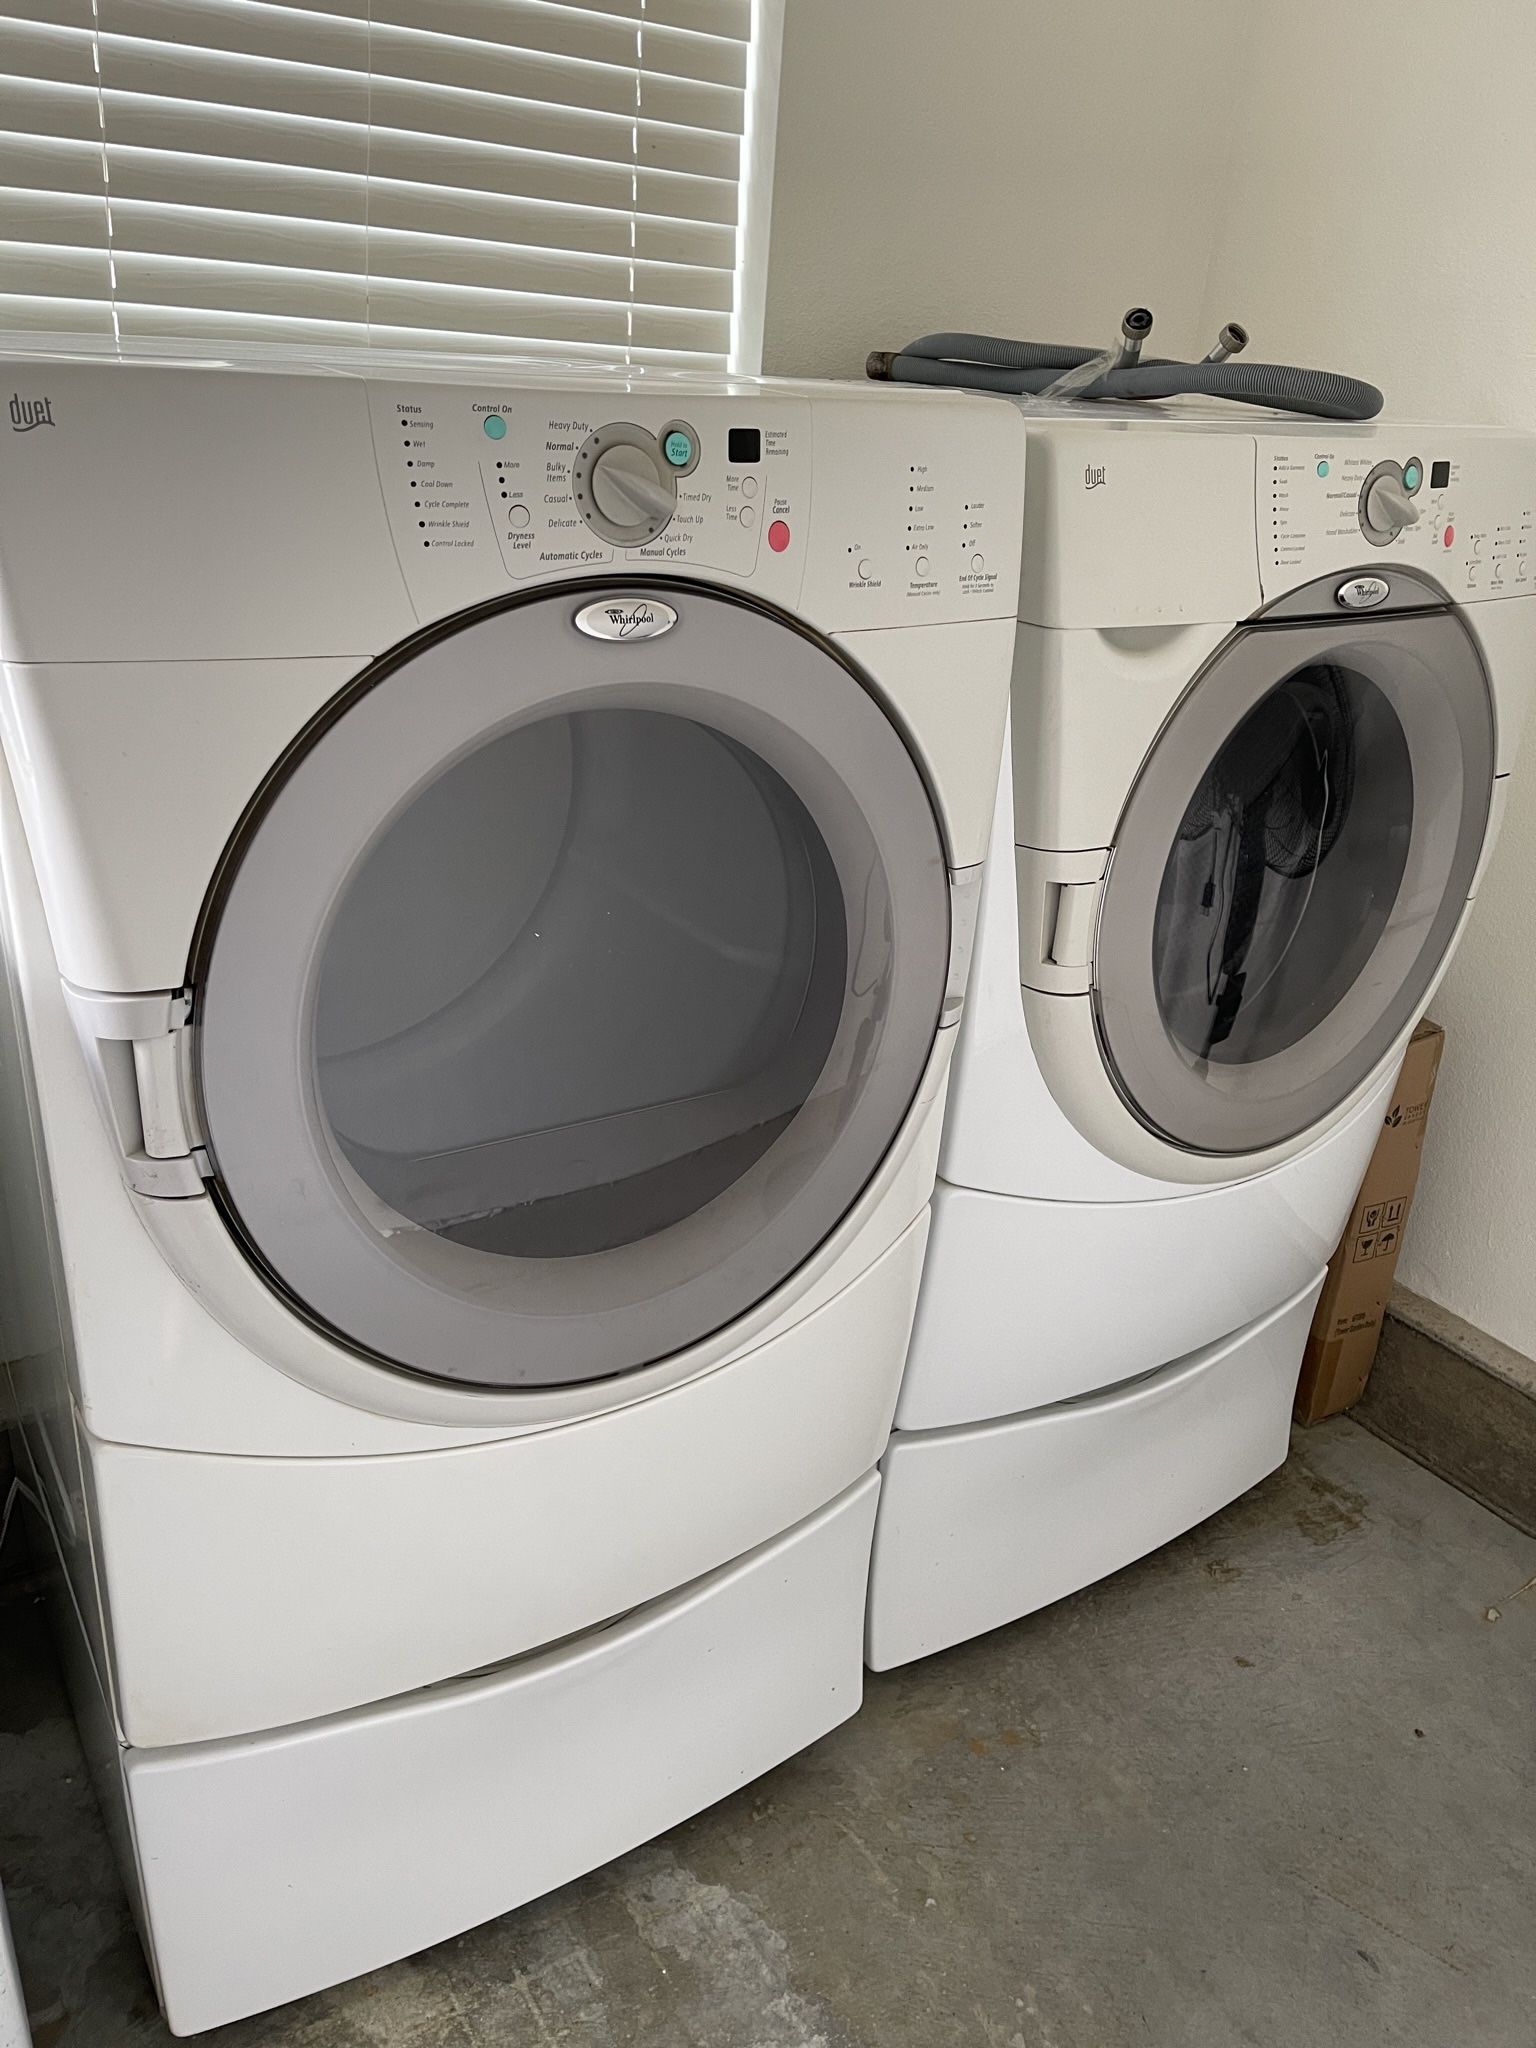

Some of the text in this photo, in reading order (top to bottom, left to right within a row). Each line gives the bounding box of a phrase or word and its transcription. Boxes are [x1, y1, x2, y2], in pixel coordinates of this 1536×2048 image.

[9, 393, 56, 432] duet
[397, 404, 422, 414] Status
[472, 404, 512, 413] Control On
[409, 420, 434, 430] Sensing
[549, 421, 589, 432] Heavy Duty
[413, 440, 426, 448] Wet
[546, 442, 574, 450] Normal
[671, 448, 688, 457] Start
[766, 448, 789, 456] Remaining
[417, 460, 435, 469] Damp
[547, 463, 566, 473] Bulky
[547, 474, 566, 482] Items
[1085, 464, 1106, 489] duet
[544, 495, 568, 503] Casual
[683, 493, 712, 502] Timed Dry
[424, 501, 469, 509] Cycle Complete
[773, 506, 790, 514] Cancel
[428, 520, 470, 528] Wrinkle Shield
[548, 519, 577, 527] Delicate
[677, 515, 704, 524] Touch Up
[508, 532, 535, 541] Dryness
[664, 533, 693, 543] Quick Dry
[513, 541, 531, 549] Level
[539, 550, 603, 561] Automatic Cycles
[640, 548, 686, 557] Manual Cycles
[867, 580, 882, 588] Shield
[910, 581, 938, 589] Temperature
[609, 612, 654, 626] Whirlpool
